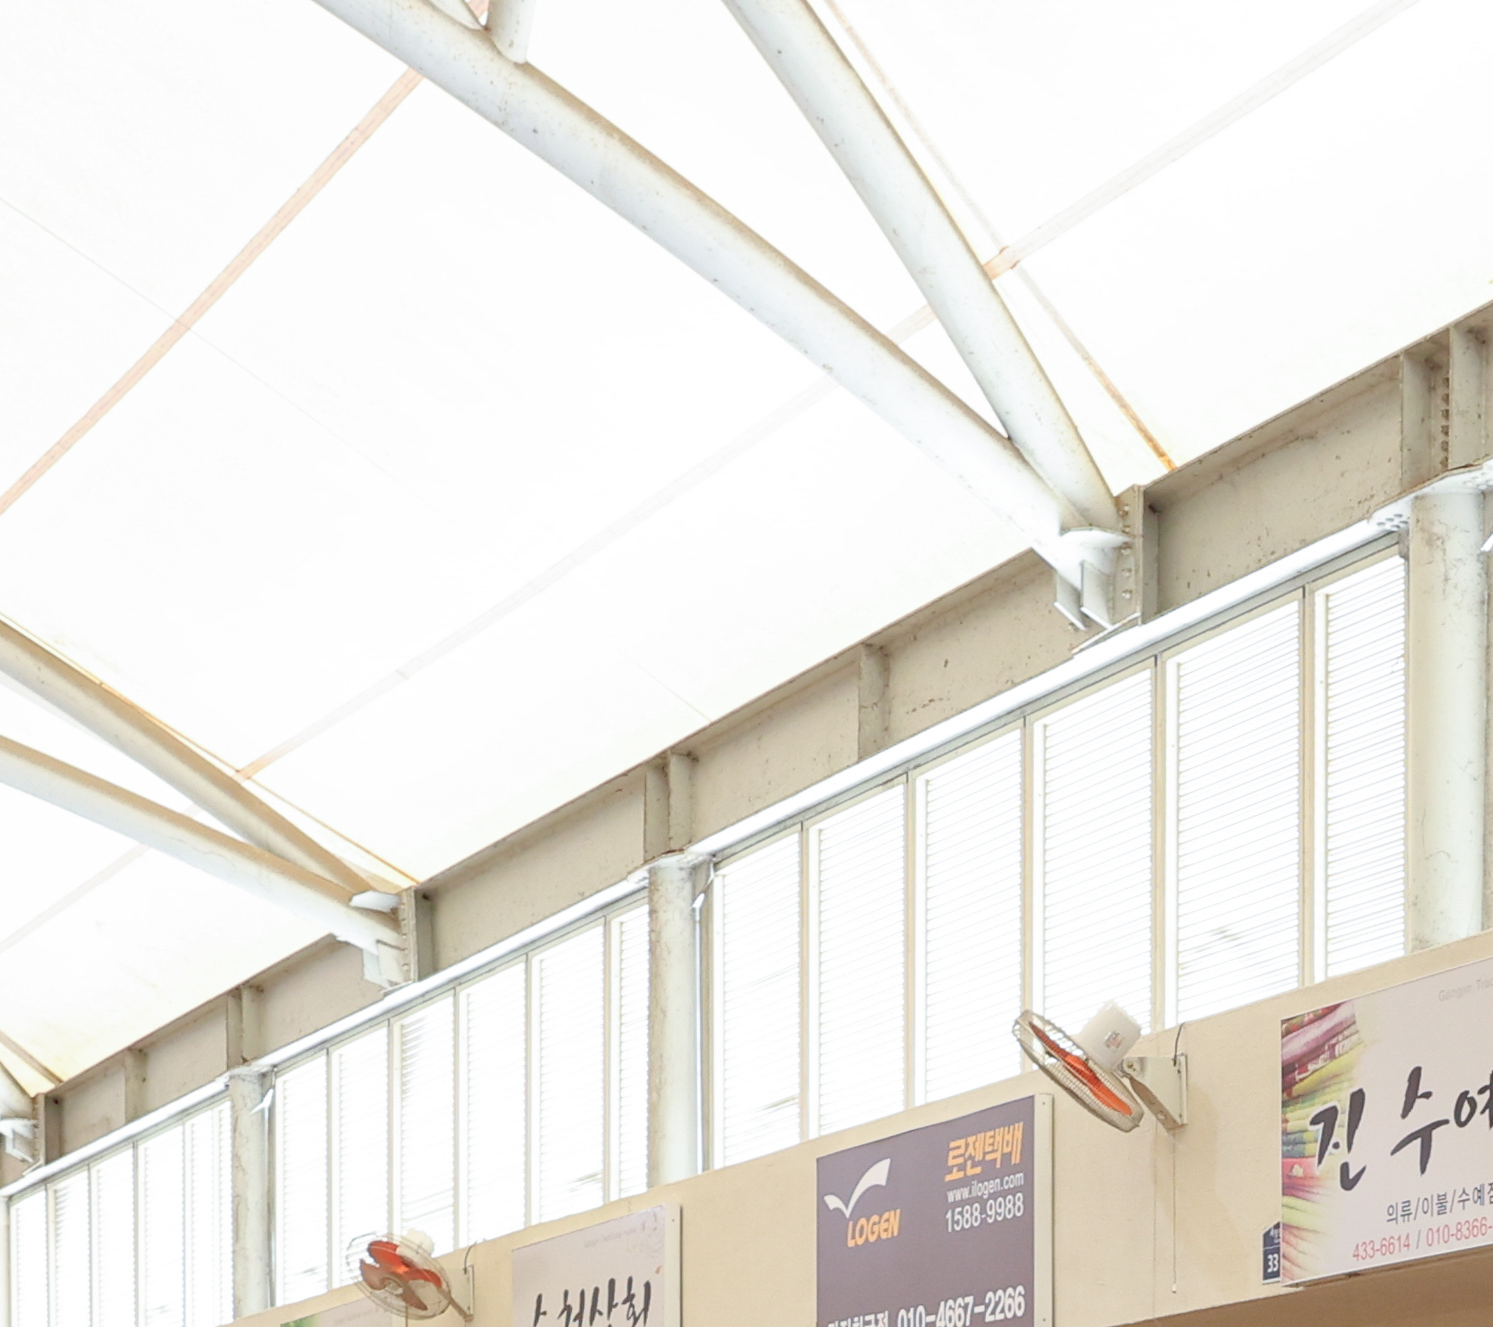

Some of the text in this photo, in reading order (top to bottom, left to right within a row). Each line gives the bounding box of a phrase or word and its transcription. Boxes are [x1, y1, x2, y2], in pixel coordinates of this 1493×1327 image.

[944, 1122, 1024, 1182] 로젠택배
[947, 1172, 1024, 1203] www.ilogen.com
[847, 1209, 901, 1248] LOGEN
[946, 1192, 1024, 1232] 1588-9988
[1267, 1253, 1279, 1273] 33
[1352, 1232, 1411, 1261] 433-6614
